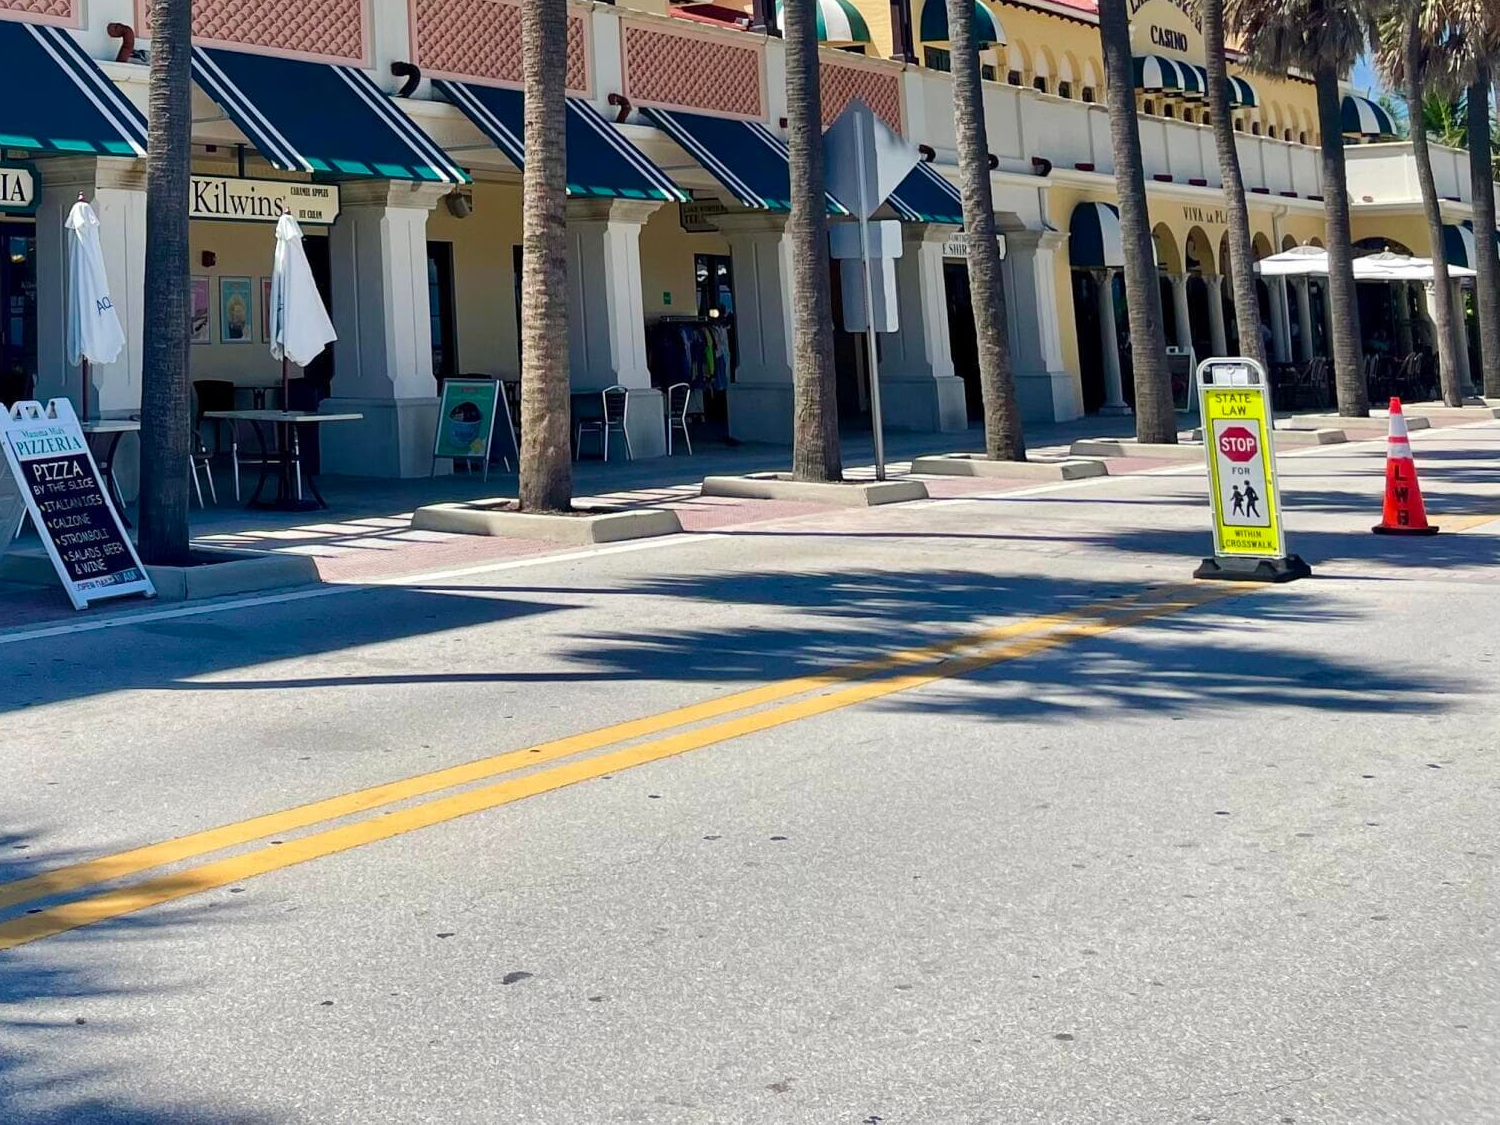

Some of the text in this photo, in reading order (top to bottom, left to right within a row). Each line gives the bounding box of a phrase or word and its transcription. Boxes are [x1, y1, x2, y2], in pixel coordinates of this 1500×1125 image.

[1151, 25, 1188, 52] CASINO
[192, 180, 283, 217] Kilwins
[1183, 206, 1204, 222] VIVA
[949, 243, 967, 255] SHIR
[1215, 393, 1252, 403] STATE
[1222, 406, 1247, 416] LAW
[16, 436, 82, 456] PIZZERIA
[1221, 437, 1255, 452] STOP
[32, 460, 84, 482] PIZZA
[1232, 467, 1251, 475] FOR
[33, 477, 96, 496] BY THE SLICE
[44, 494, 103, 512] ITALIAN ICES
[53, 513, 92, 529] CALZONE
[60, 528, 110, 546] STROMBOLI
[1234, 530, 1262, 538] WITHIN
[103, 542, 124, 555] BEER
[1225, 539, 1273, 548] CROSSWALK
[74, 558, 108, 575] & WINE
